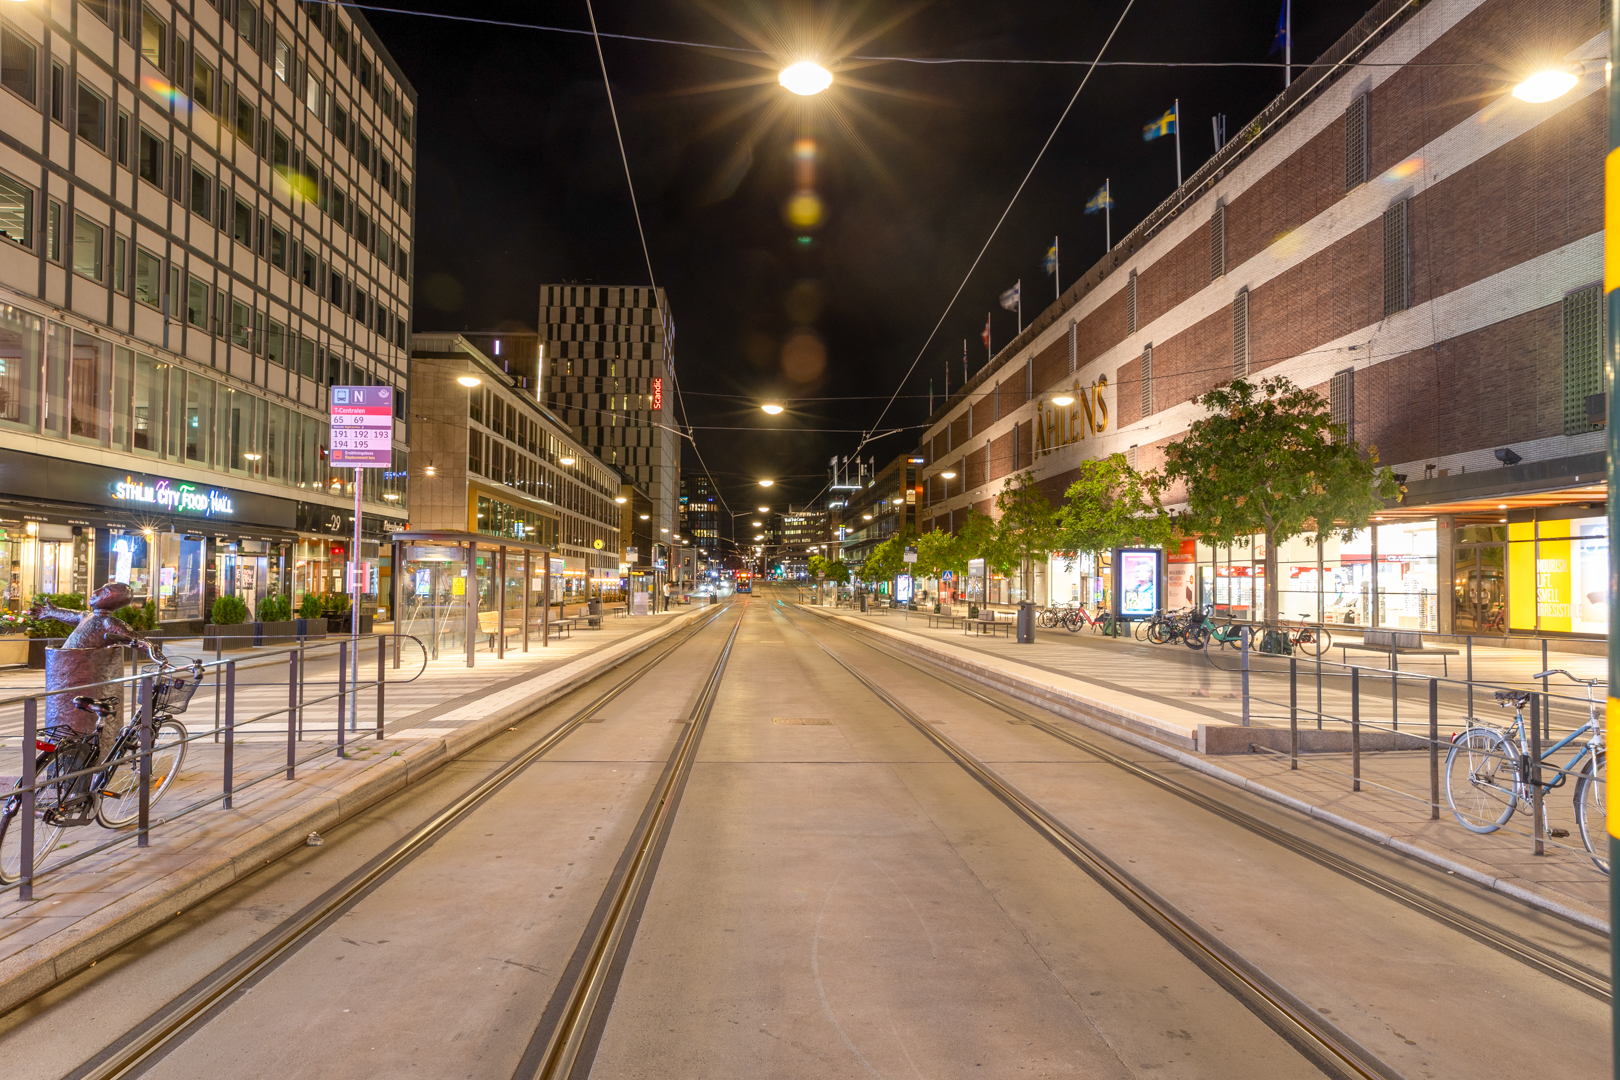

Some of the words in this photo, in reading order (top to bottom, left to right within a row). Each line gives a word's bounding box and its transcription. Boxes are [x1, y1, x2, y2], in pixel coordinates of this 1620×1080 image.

[354, 391, 364, 402] N
[653, 378, 662, 409] Scandic
[334, 430, 348, 438] 191
[354, 430, 369, 438] 192
[334, 440, 348, 448] 194
[354, 440, 369, 449] 195
[113, 480, 156, 503] STHLM
[156, 482, 181, 508] CITY
[180, 486, 209, 511] FOOD
[1537, 559, 1570, 573] NOURISH.
[1537, 573, 1553, 588] LIFT.
[1537, 588, 1560, 602] SMELL
